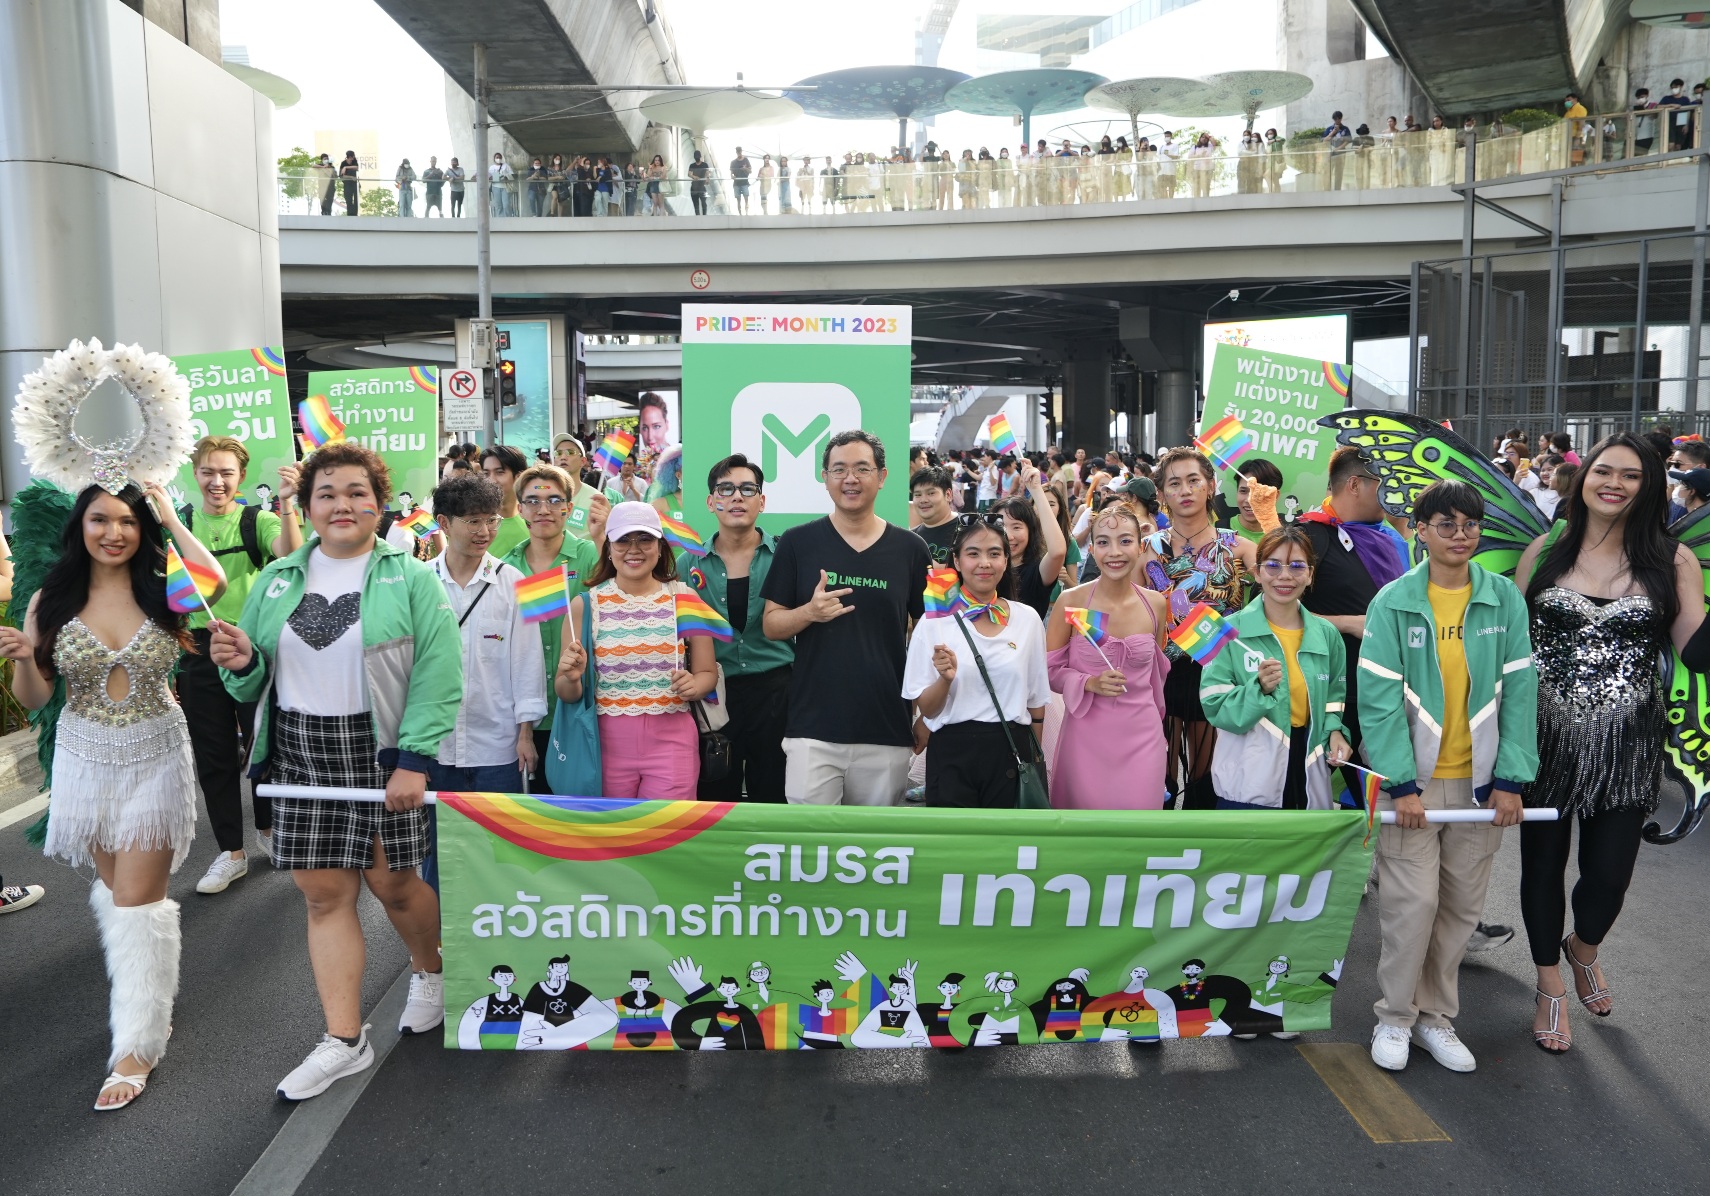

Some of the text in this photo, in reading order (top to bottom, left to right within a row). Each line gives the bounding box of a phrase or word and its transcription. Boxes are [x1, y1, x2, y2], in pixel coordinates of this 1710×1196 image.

[696, 316, 898, 333] PRIDE MONTH 2023
[329, 378, 416, 397] สวัสดิการ
[1237, 355, 1326, 388] พนักงาน
[1234, 378, 1319, 411] แต่งงาน
[226, 410, 277, 443] วัน
[1249, 408, 1321, 435] 20,000
[744, 843, 914, 884] สมรส
[938, 845, 1333, 930] เท่าเทียม
[471, 881, 907, 939] สวัสดิการที่ทำงาน
